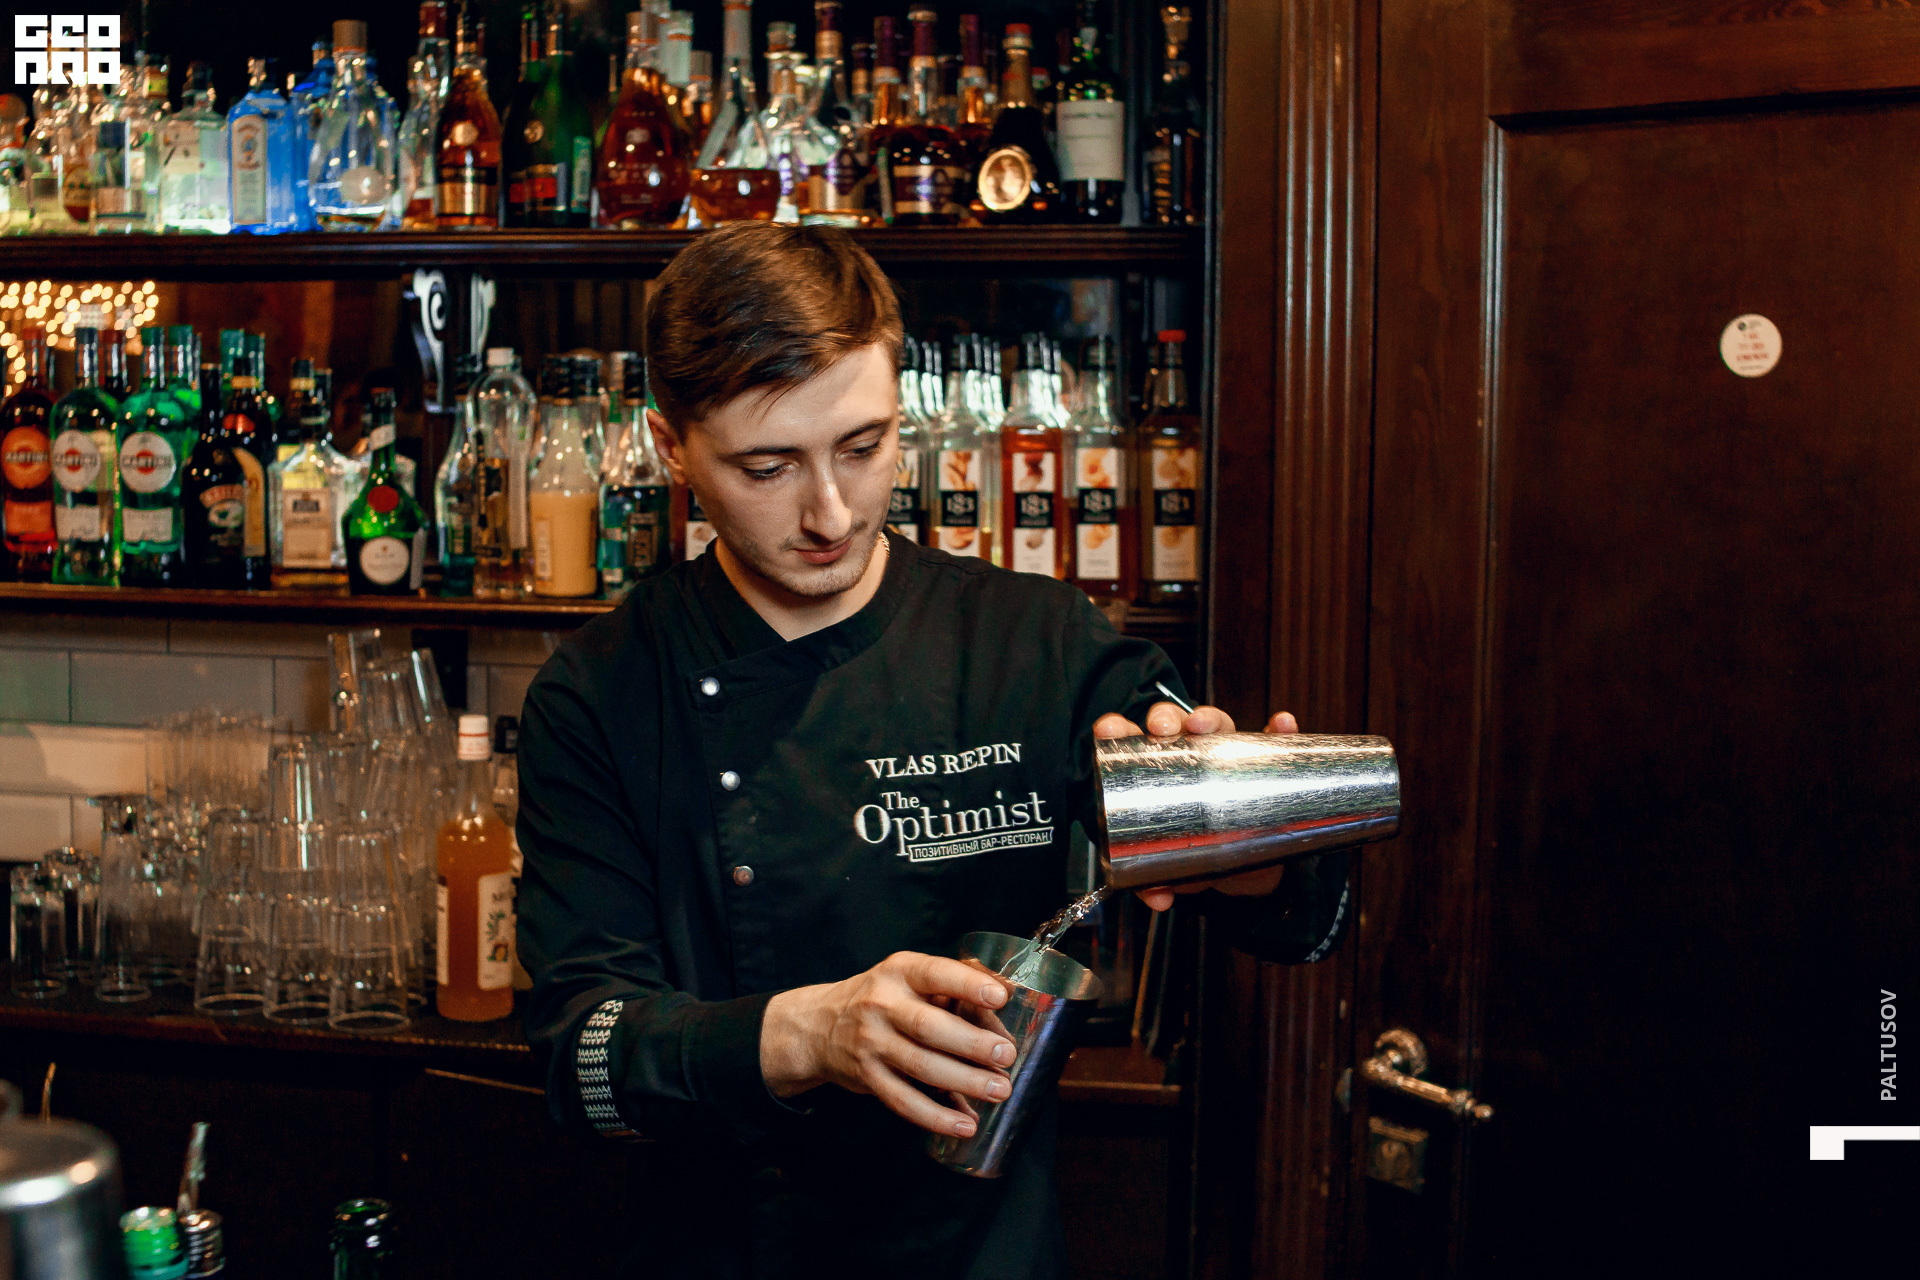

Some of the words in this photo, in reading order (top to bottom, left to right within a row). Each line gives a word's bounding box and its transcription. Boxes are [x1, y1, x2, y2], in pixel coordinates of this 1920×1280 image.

[864, 754, 937, 779] VLAS
[940, 743, 1021, 774] REPIN
[881, 791, 920, 811] The
[853, 790, 1052, 857] Optimist
[914, 839, 980, 859] ПОЗИТИВНЫЙ
[980, 831, 1049, 850] БАР-РЕСТОРАН
